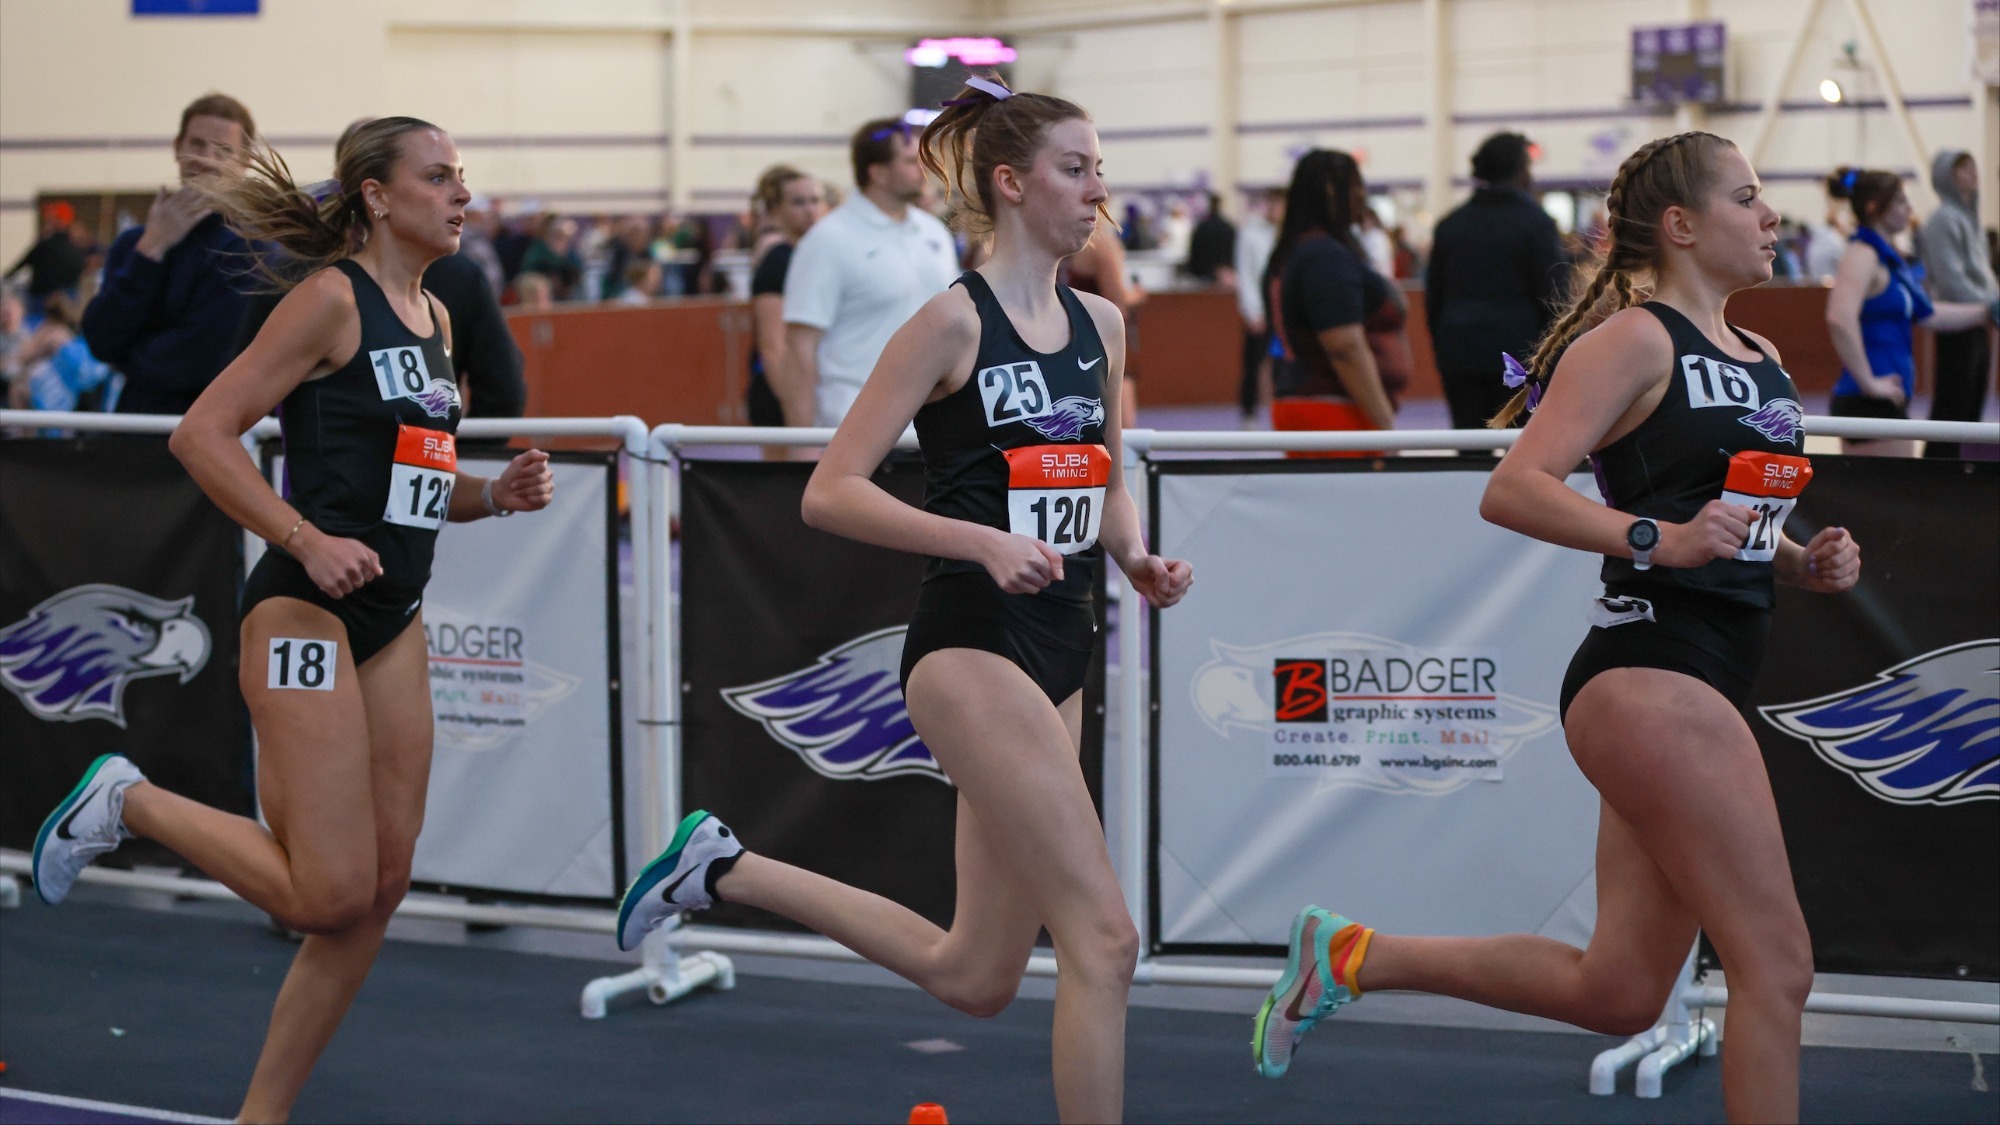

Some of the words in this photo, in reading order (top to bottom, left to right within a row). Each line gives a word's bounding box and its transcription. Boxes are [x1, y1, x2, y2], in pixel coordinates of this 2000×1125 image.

[375, 349, 425, 397] 18
[1689, 357, 1750, 404] 16
[985, 363, 1044, 423] 25
[423, 437, 452, 454] SUB
[1041, 453, 1089, 467] SUB4
[1042, 468, 1088, 478] TIMING
[1763, 463, 1799, 478] SUB4
[409, 474, 451, 521] 123
[1762, 478, 1794, 489] TIMING
[1030, 496, 1091, 545] 120
[273, 640, 325, 688] 18
[1331, 658, 1496, 693] BADGER
[1272, 661, 1328, 720] B
[1332, 704, 1407, 725] graphic
[1413, 706, 1497, 725] systems
[1366, 730, 1429, 744] Print.
[1273, 754, 1361, 767] 800.441.6789
[1379, 755, 1498, 771] www.bgsinc.com
